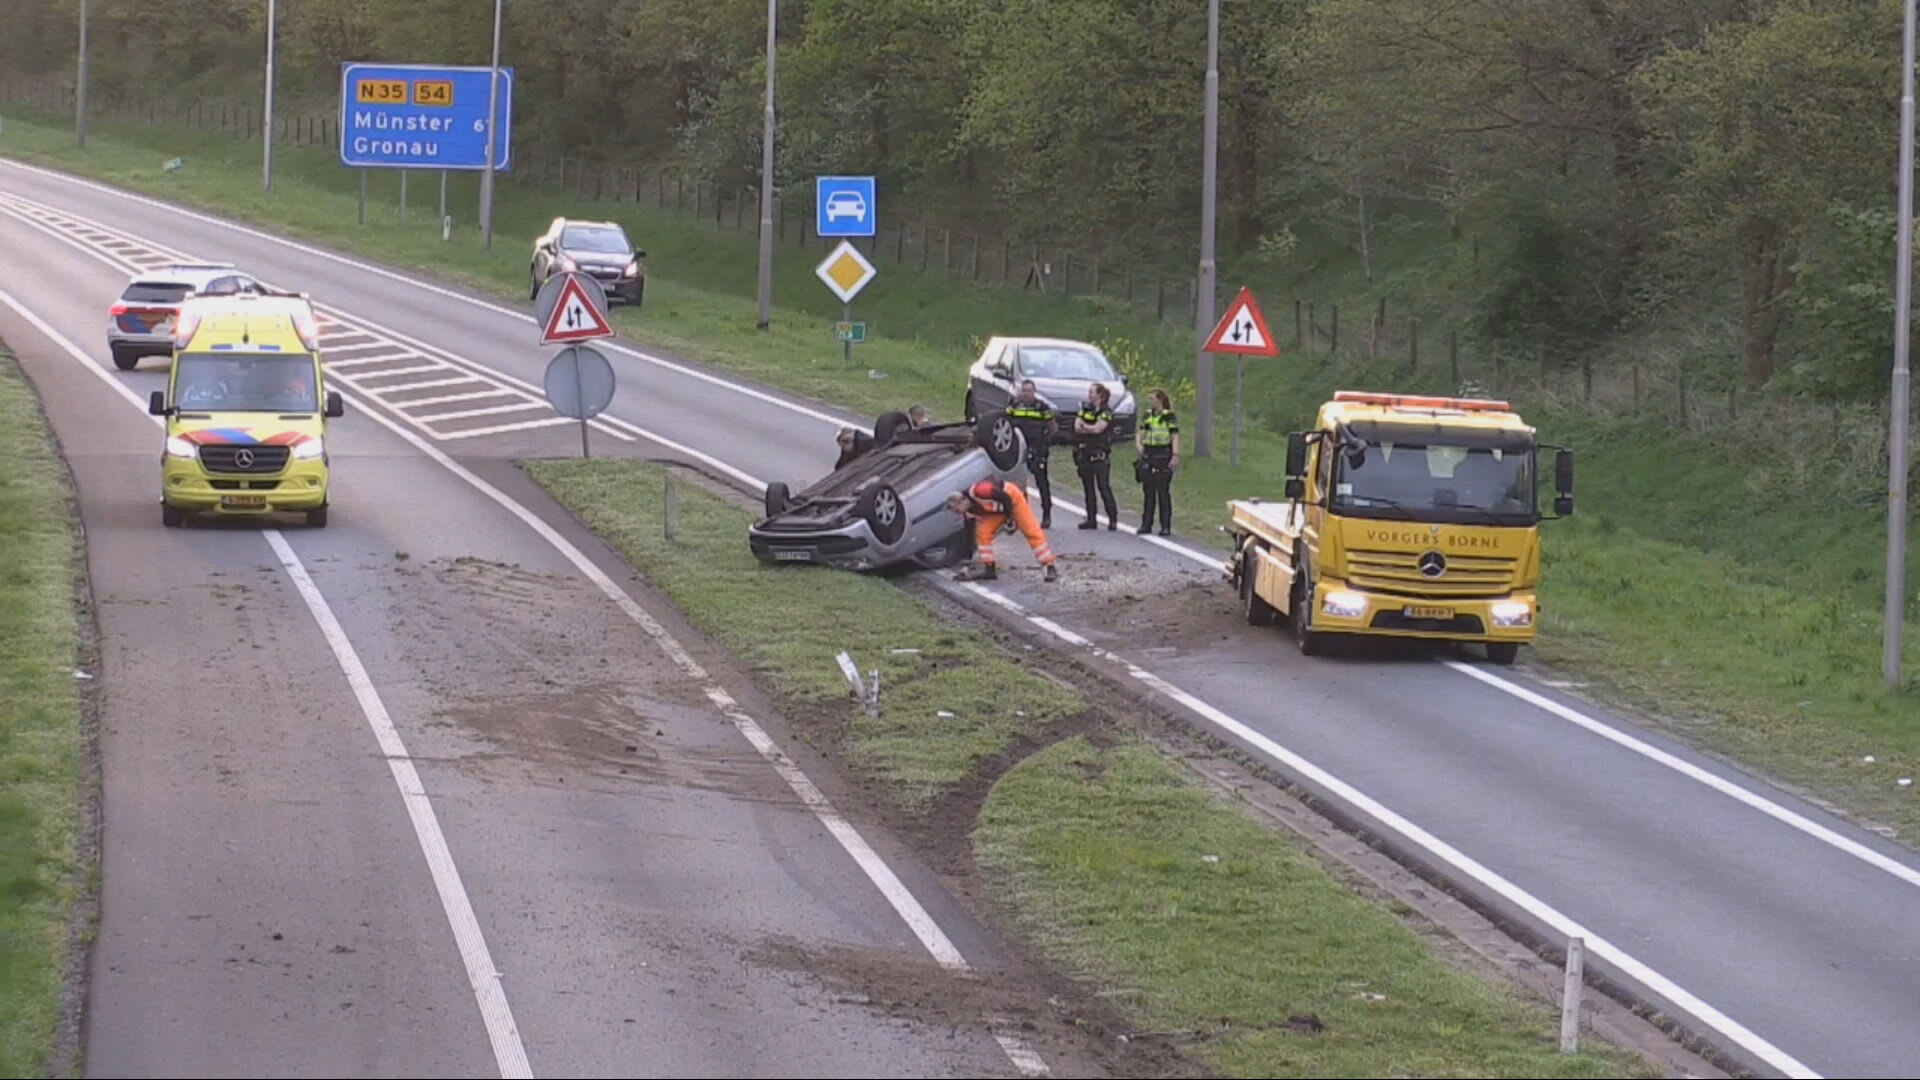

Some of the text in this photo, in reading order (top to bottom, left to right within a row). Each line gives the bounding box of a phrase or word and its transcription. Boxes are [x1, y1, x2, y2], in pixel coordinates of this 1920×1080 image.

[419, 85, 446, 100] 54
[354, 111, 454, 131] Münster
[353, 136, 438, 155] Gronau
[1367, 531, 1500, 548] VORGERS BORNE
